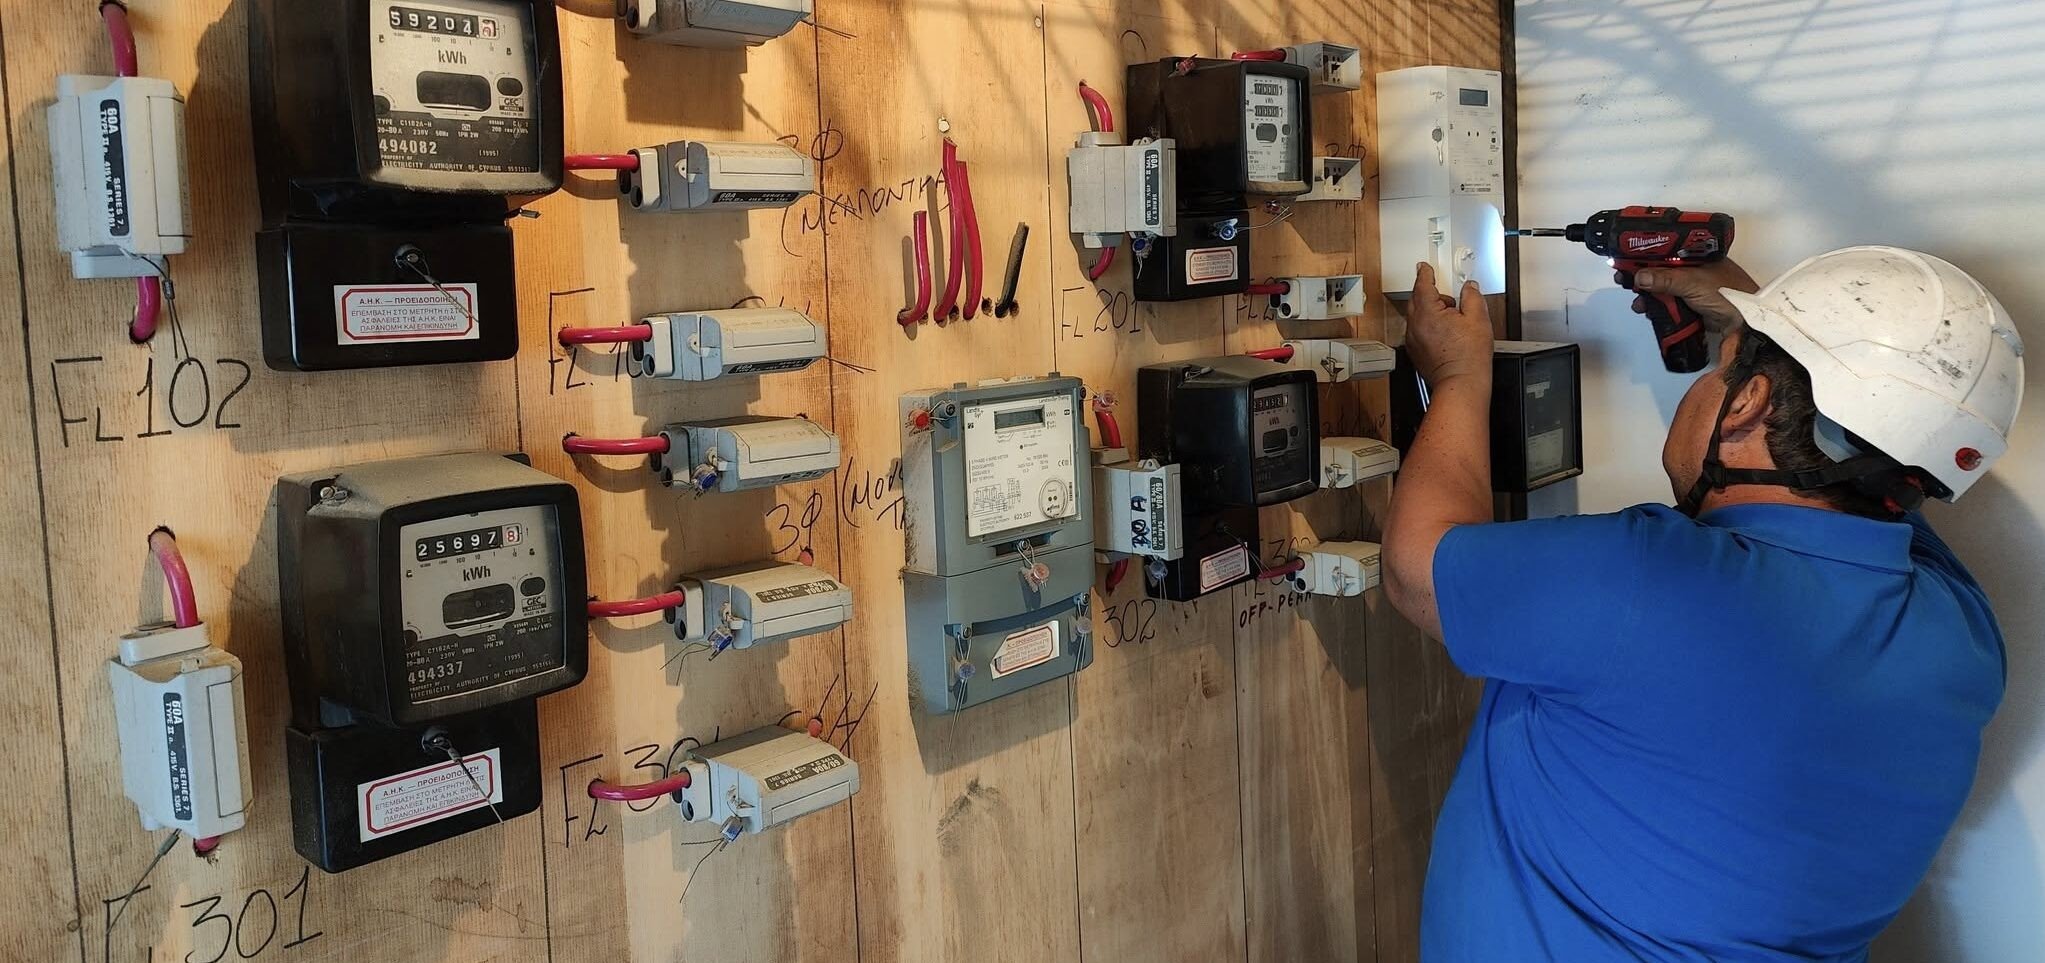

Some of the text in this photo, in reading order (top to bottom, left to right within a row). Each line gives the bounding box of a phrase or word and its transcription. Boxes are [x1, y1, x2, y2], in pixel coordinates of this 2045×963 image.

[438, 50, 467, 65] kWh
[100, 109, 109, 135] TYPE
[107, 107, 119, 134] 60A
[379, 138, 438, 154] 494082
[1150, 154, 1158, 169] 60A
[113, 177, 124, 215] SERIES
[1628, 235, 1669, 248] Milwaukee
[1094, 288, 1141, 333] 201
[137, 356, 251, 438] 102
[462, 565, 491, 582] kWh
[1101, 599, 1157, 648] 302
[408, 661, 463, 684] 494337
[165, 702, 174, 725] TYPE
[172, 700, 183, 725] 60A
[417, 765, 479, 787] ΠΡΟΕΙΔΟΠΟΙΣΗ
[811, 759, 841, 774] 60/80A
[179, 767, 189, 802] SERIES
[180, 866, 323, 963] 301
